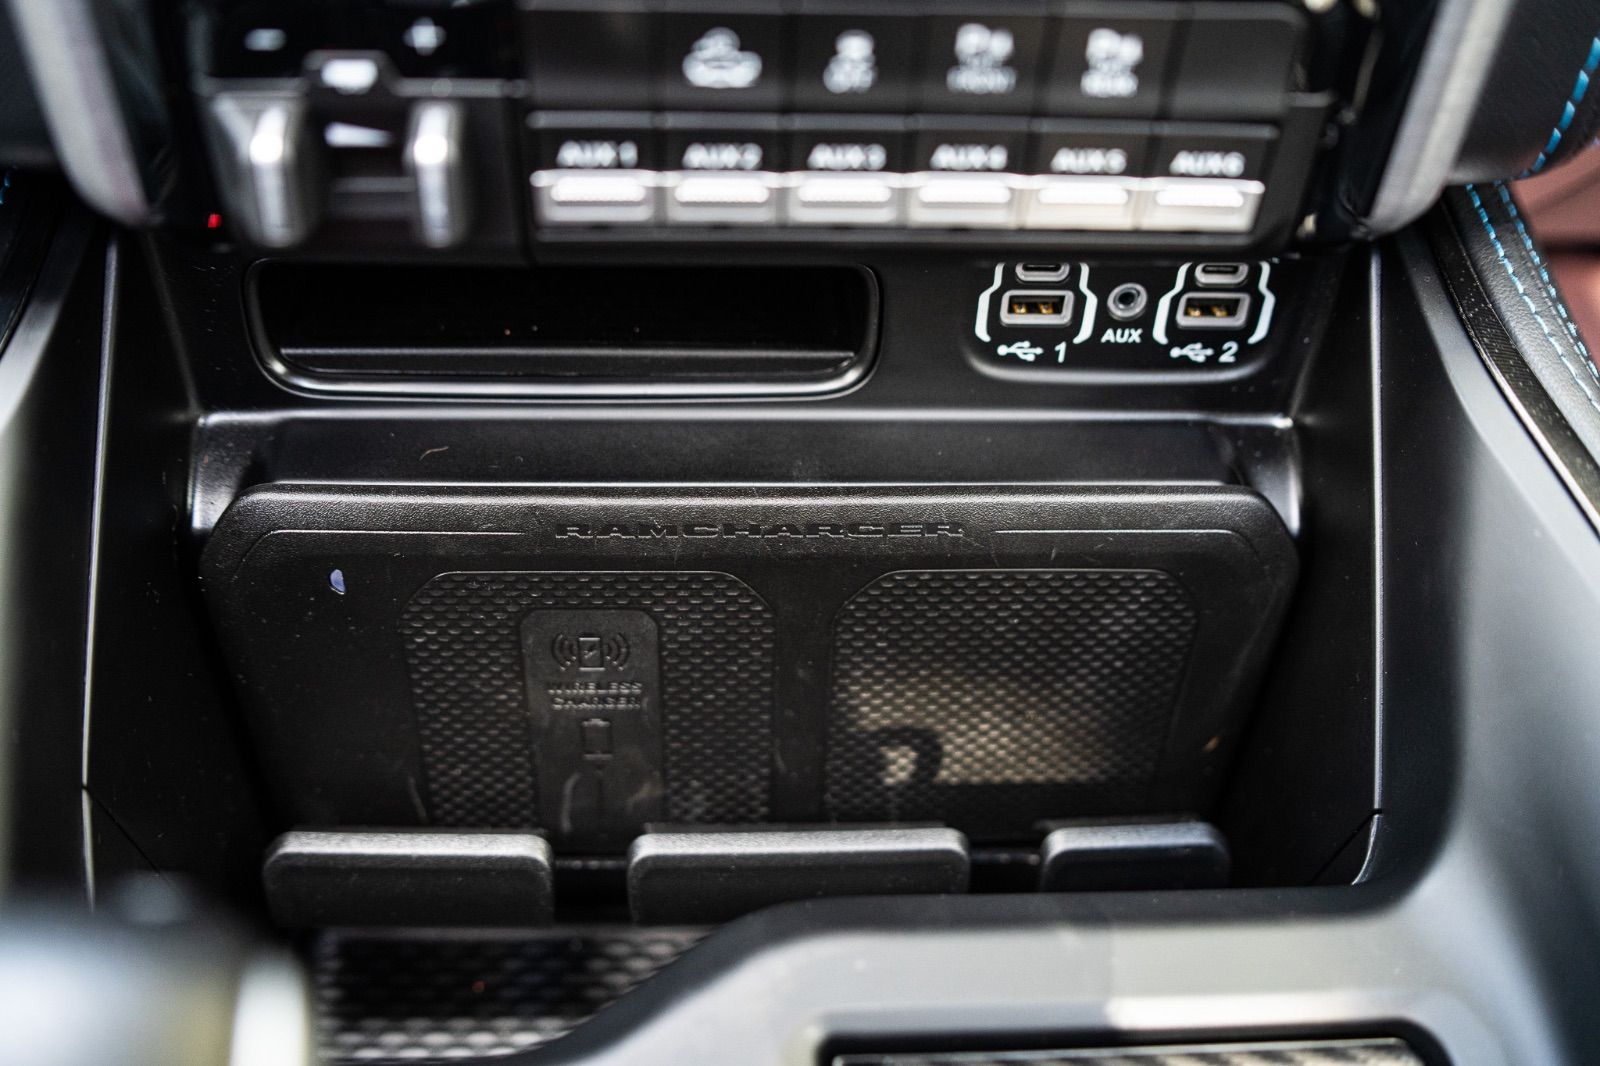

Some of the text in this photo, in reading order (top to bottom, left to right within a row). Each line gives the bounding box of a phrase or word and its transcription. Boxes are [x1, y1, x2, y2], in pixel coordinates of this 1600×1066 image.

[1101, 328, 1143, 344] AUX
[1054, 341, 1067, 363] 1
[1218, 341, 1239, 363] 2
[555, 523, 965, 539] RAMCHARGER
